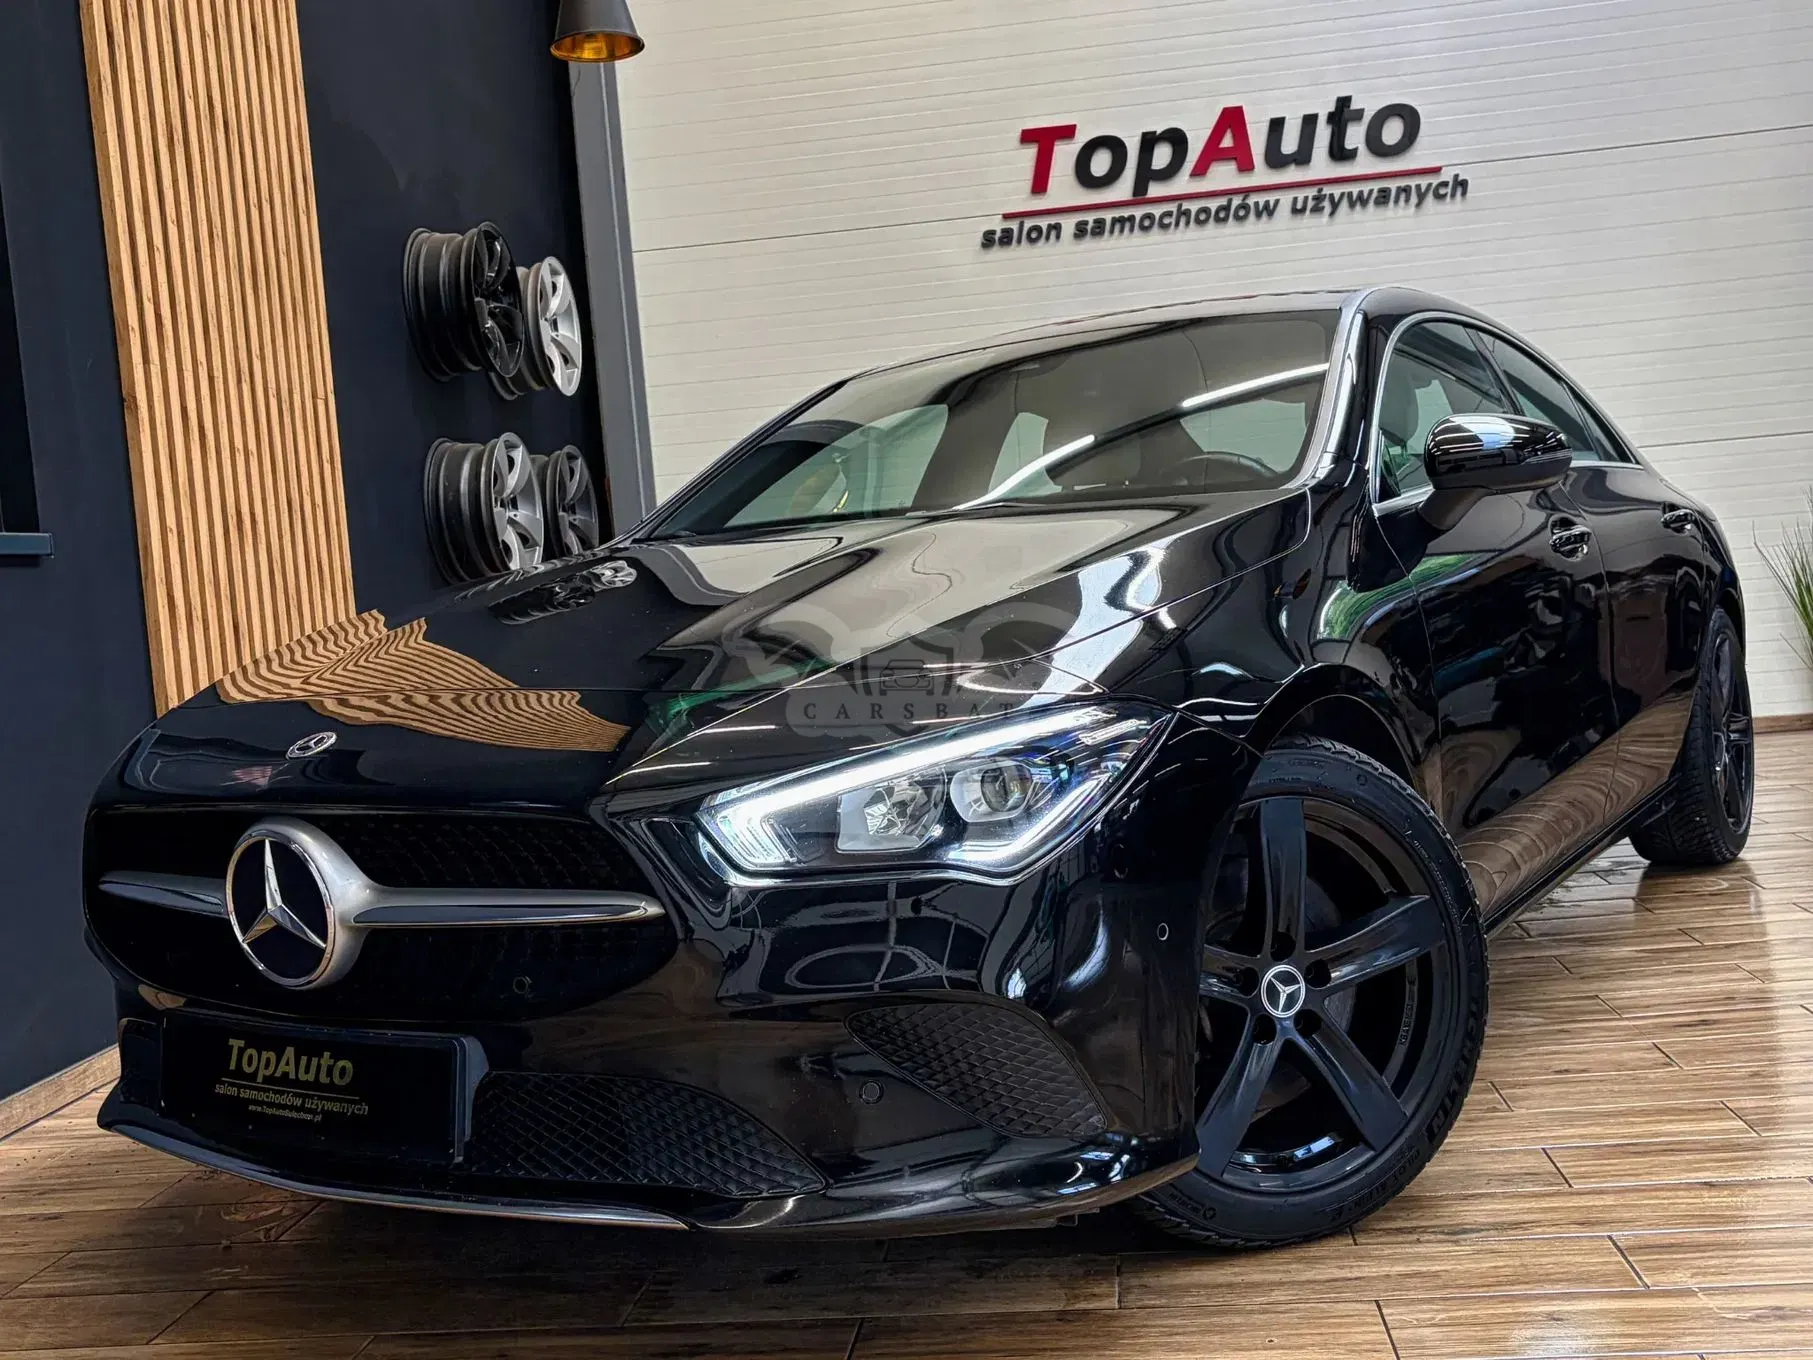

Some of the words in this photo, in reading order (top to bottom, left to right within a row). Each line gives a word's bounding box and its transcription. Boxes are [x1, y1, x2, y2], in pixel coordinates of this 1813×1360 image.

[1020, 95, 1421, 197] TopAuto
[981, 220, 1062, 249] salon
[1073, 193, 1280, 238] samochodów
[1290, 174, 1469, 217] używanych
[228, 1037, 354, 1086] TopAuto
[215, 1083, 238, 1097] salon
[239, 1087, 303, 1107] samochodów
[305, 1096, 369, 1116] używanych
